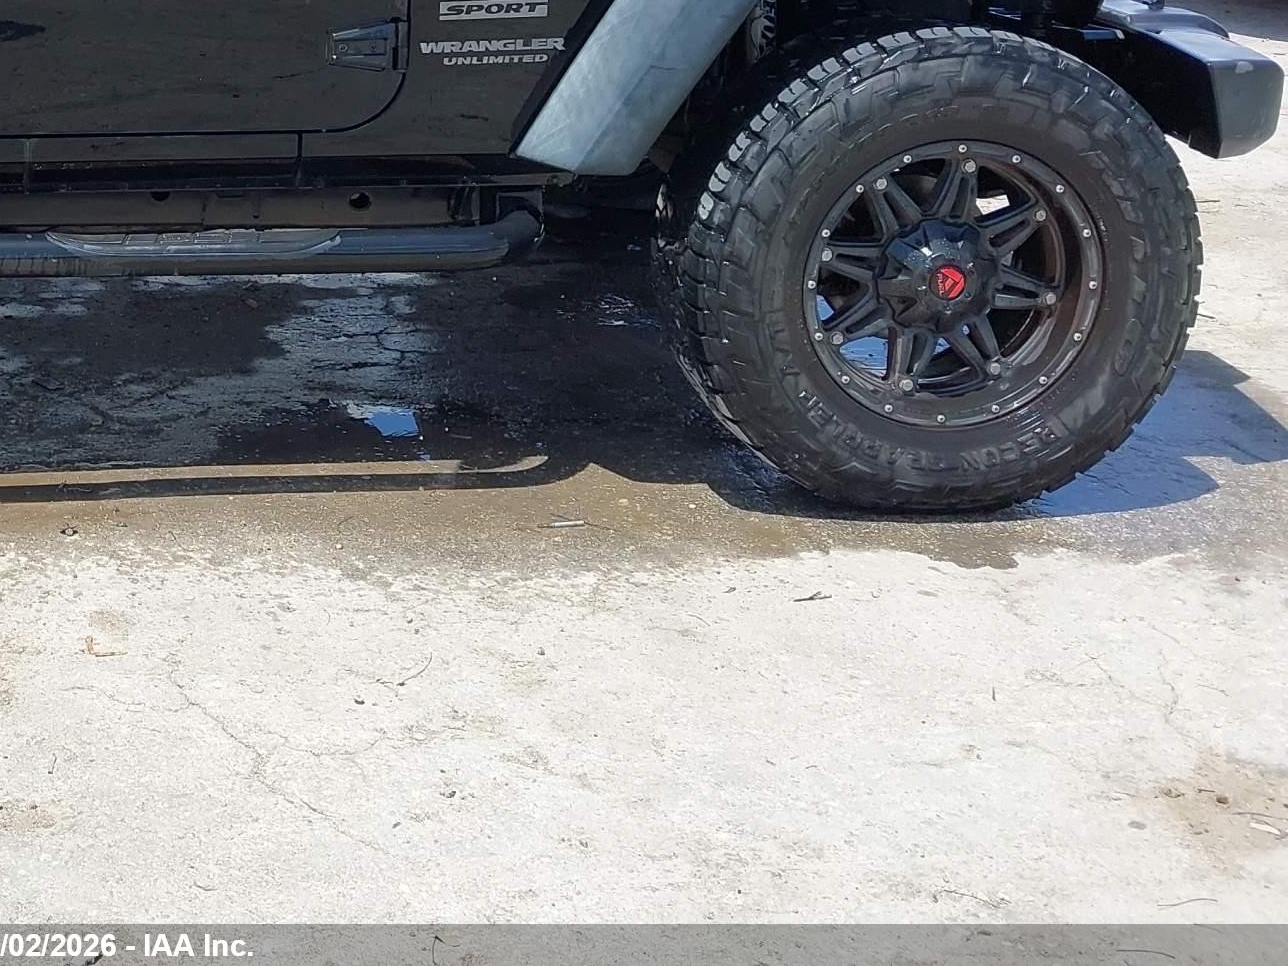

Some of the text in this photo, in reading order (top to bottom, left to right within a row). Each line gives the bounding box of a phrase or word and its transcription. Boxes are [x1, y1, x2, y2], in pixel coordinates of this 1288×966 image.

[440, 1, 548, 16] SPORT
[419, 37, 567, 54] WRANGLER
[442, 54, 549, 66] UNLIMITED
